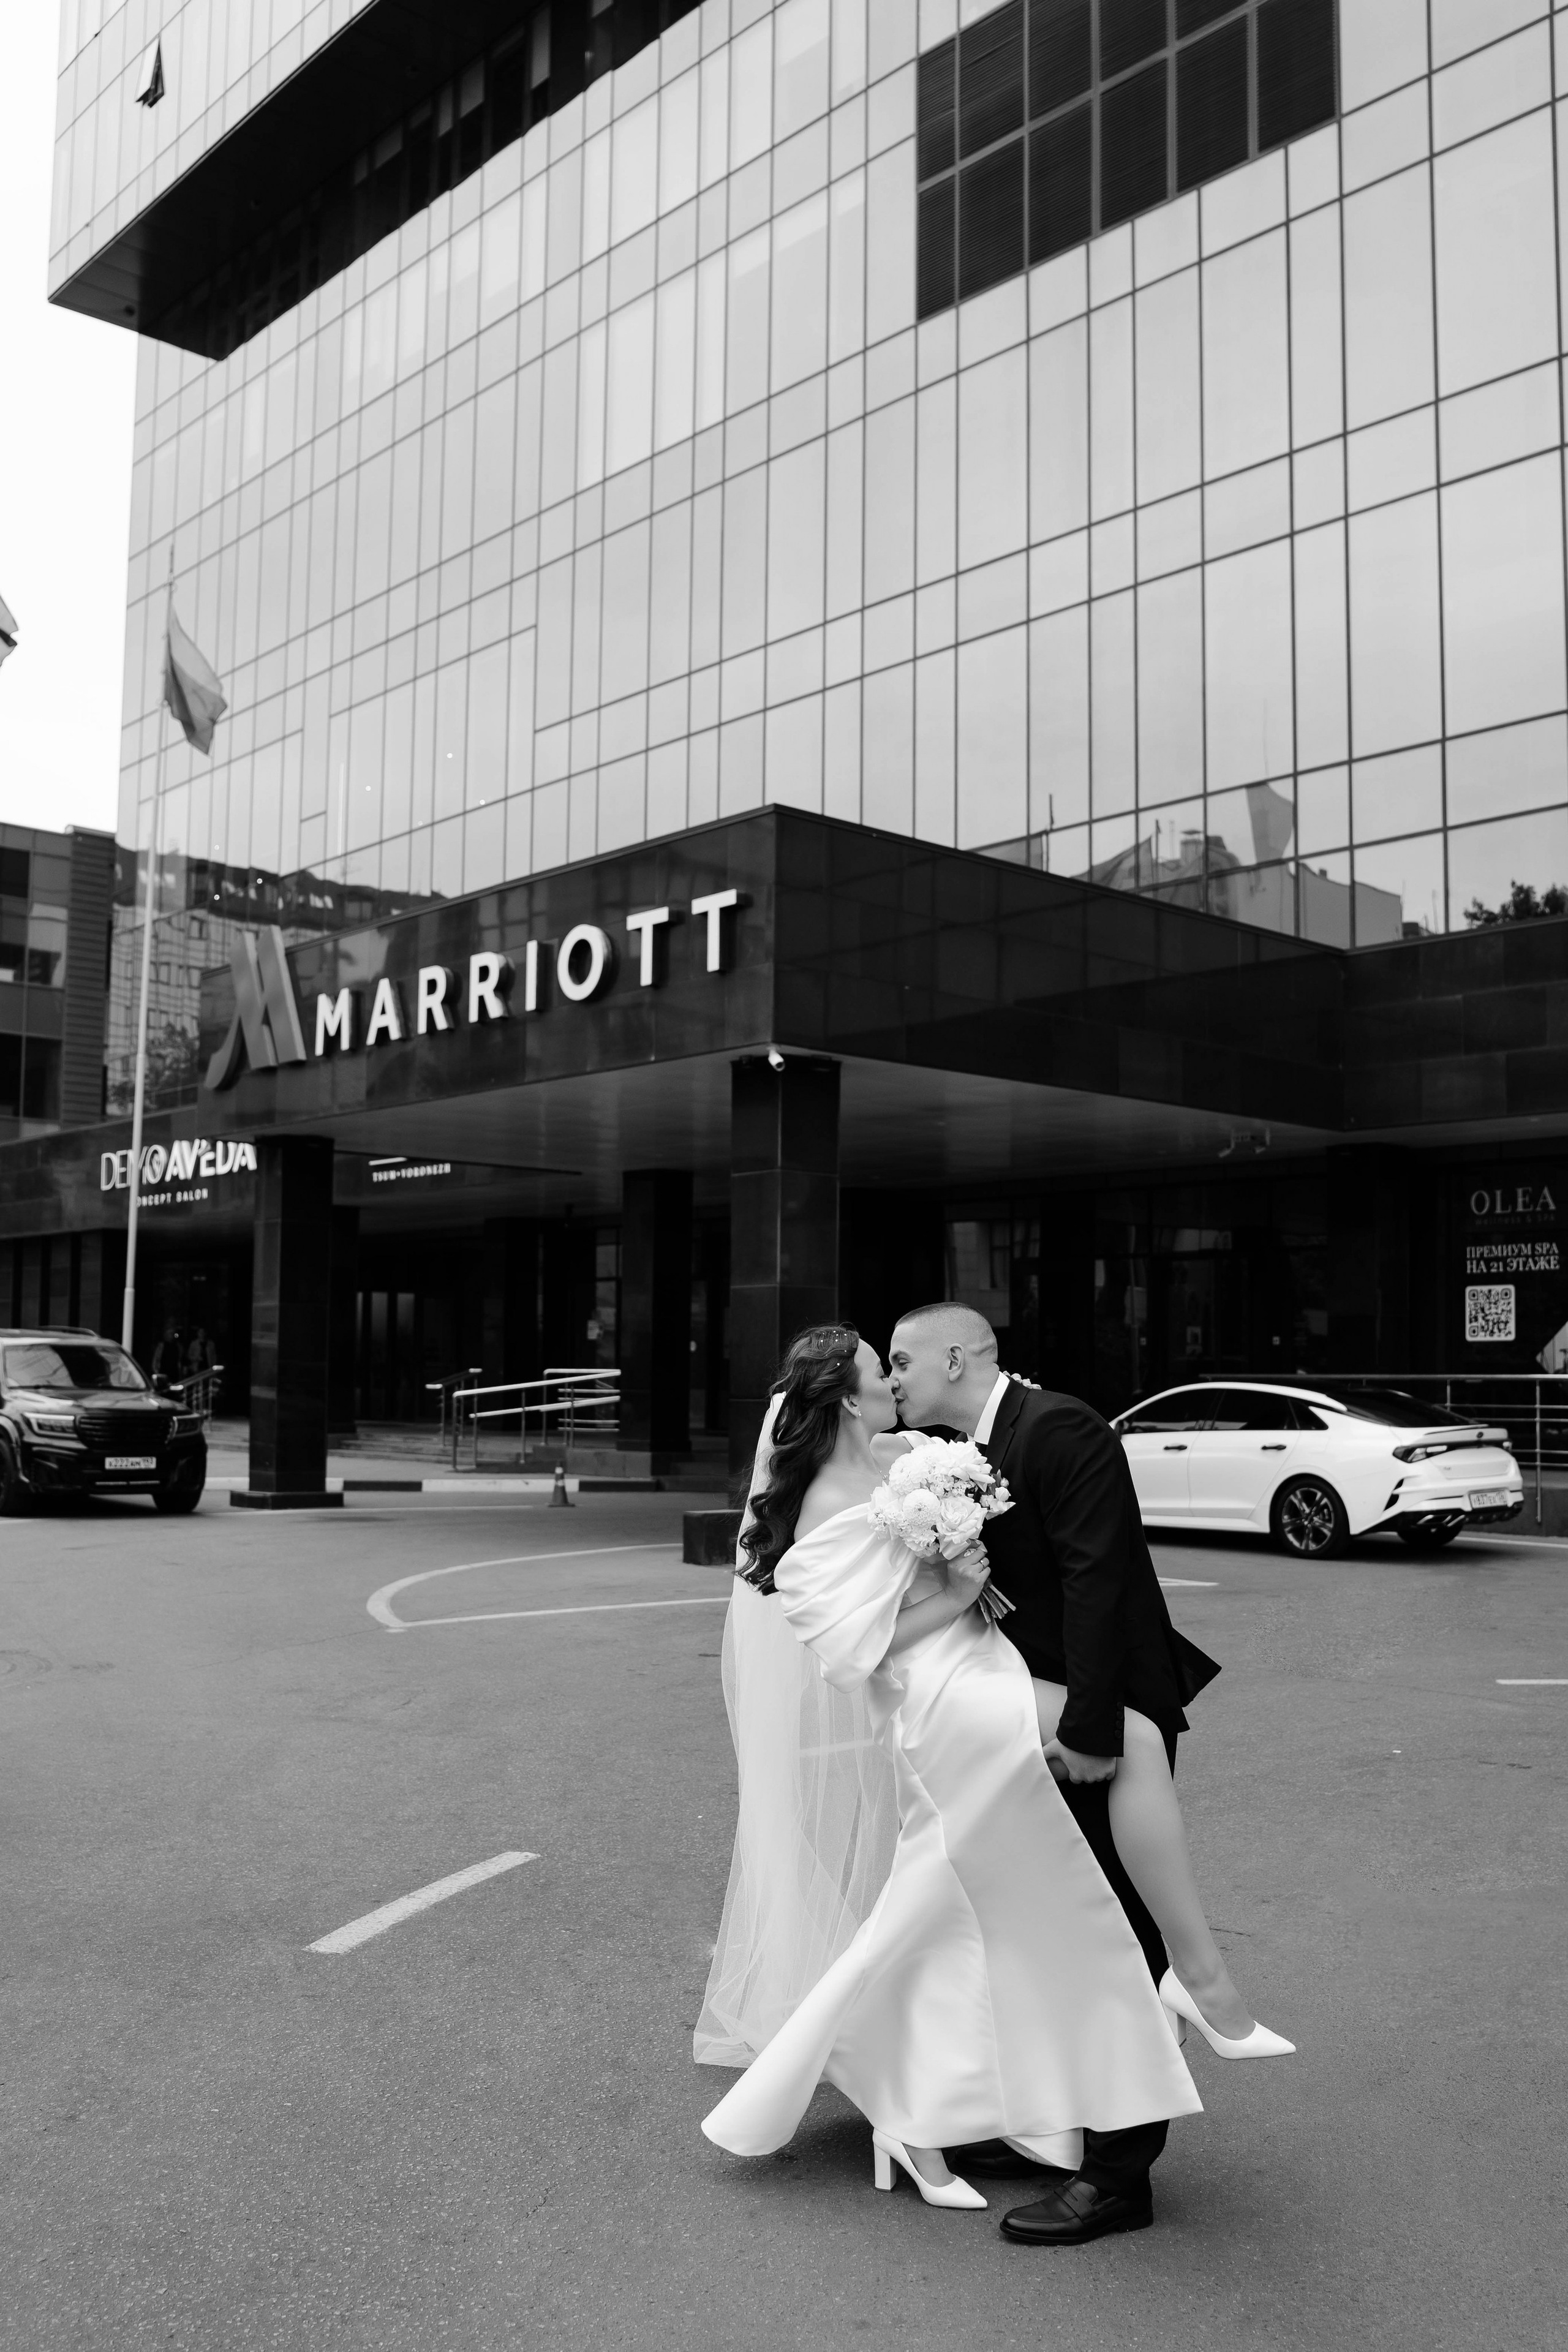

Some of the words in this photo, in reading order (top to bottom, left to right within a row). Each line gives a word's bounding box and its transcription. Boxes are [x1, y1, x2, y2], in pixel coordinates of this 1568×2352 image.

[314, 888, 739, 1057] MARRIOTT
[136, 1192, 172, 1208] ONCEPT
[176, 1187, 208, 1204] SALON
[1469, 1185, 1557, 1216] OLEA
[1466, 1242, 1532, 1259] ПРЕМИУМ
[1534, 1242, 1559, 1256] SPA
[1466, 1259, 1488, 1275] НА
[1490, 1261, 1504, 1273] 21
[1506, 1255, 1561, 1272] ЭТАЖЕ
